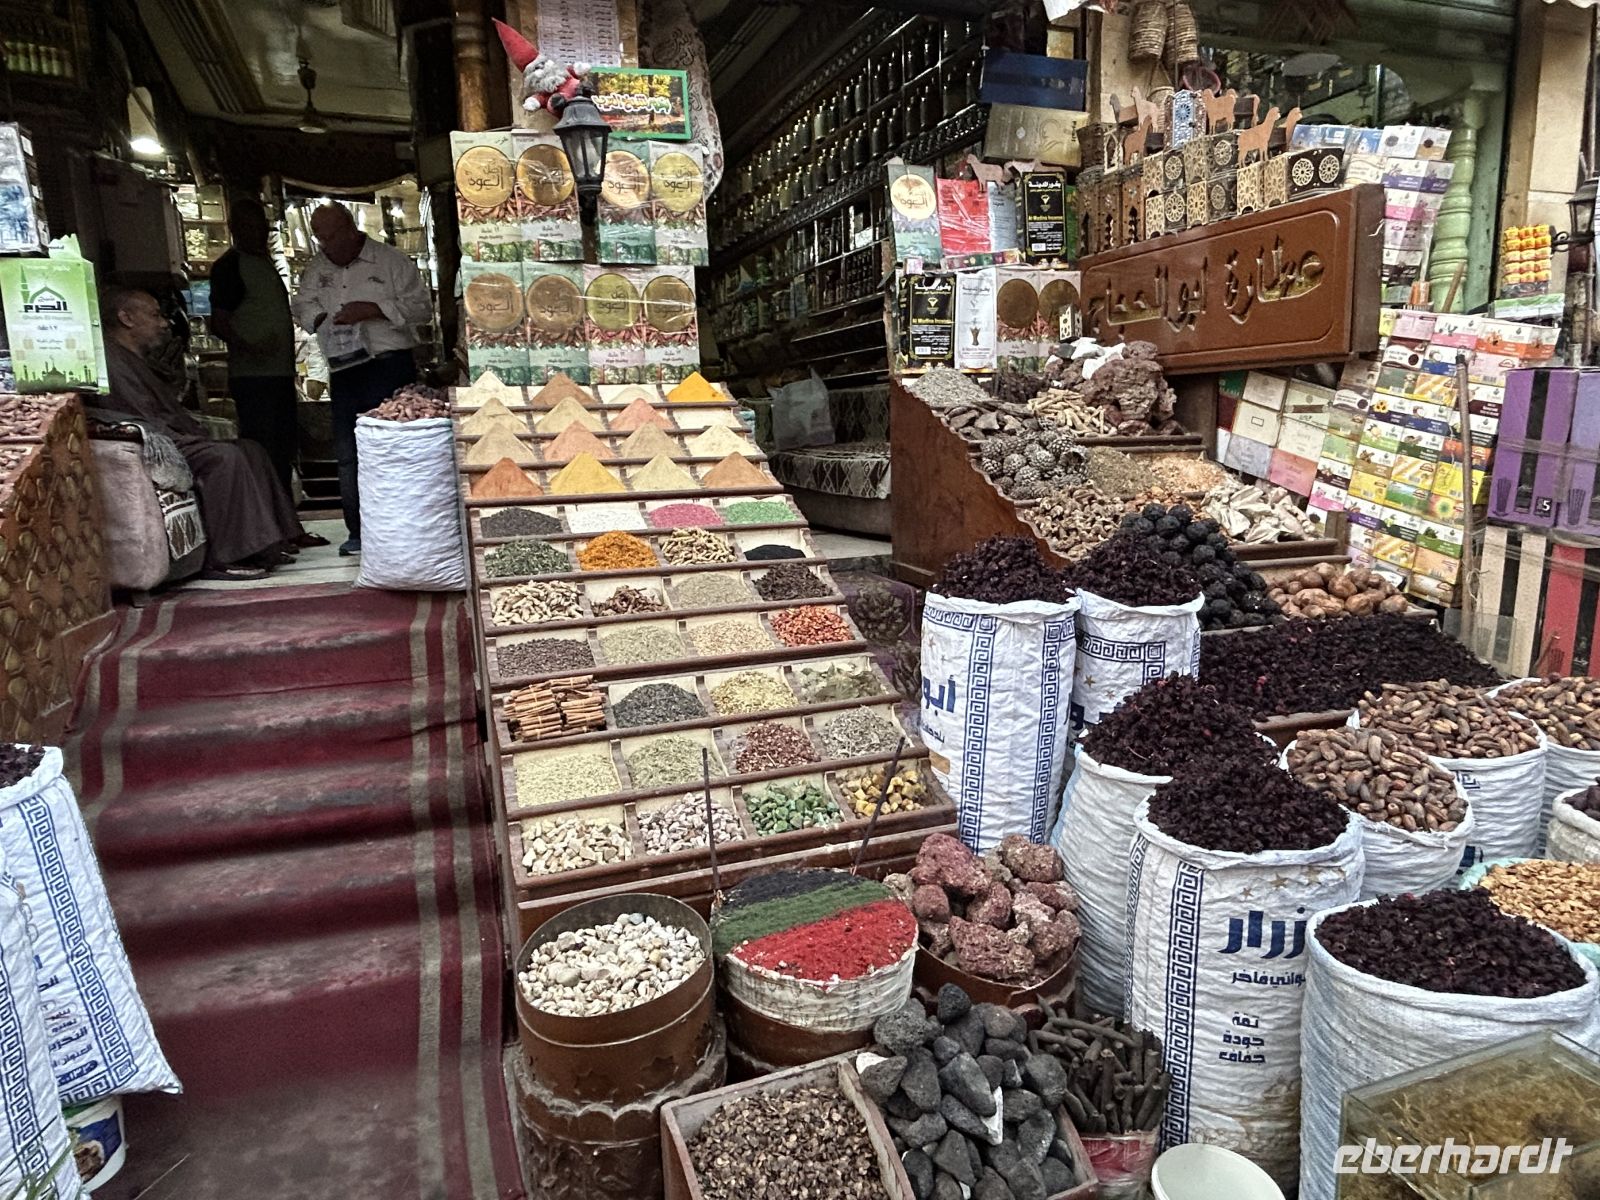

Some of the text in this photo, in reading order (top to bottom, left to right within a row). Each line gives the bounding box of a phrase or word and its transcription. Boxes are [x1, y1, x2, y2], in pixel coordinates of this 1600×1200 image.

[1224, 234, 1325, 325] عطارة
[23, 301, 68, 313] الحرم
[1223, 1030, 1265, 1049] جودة
